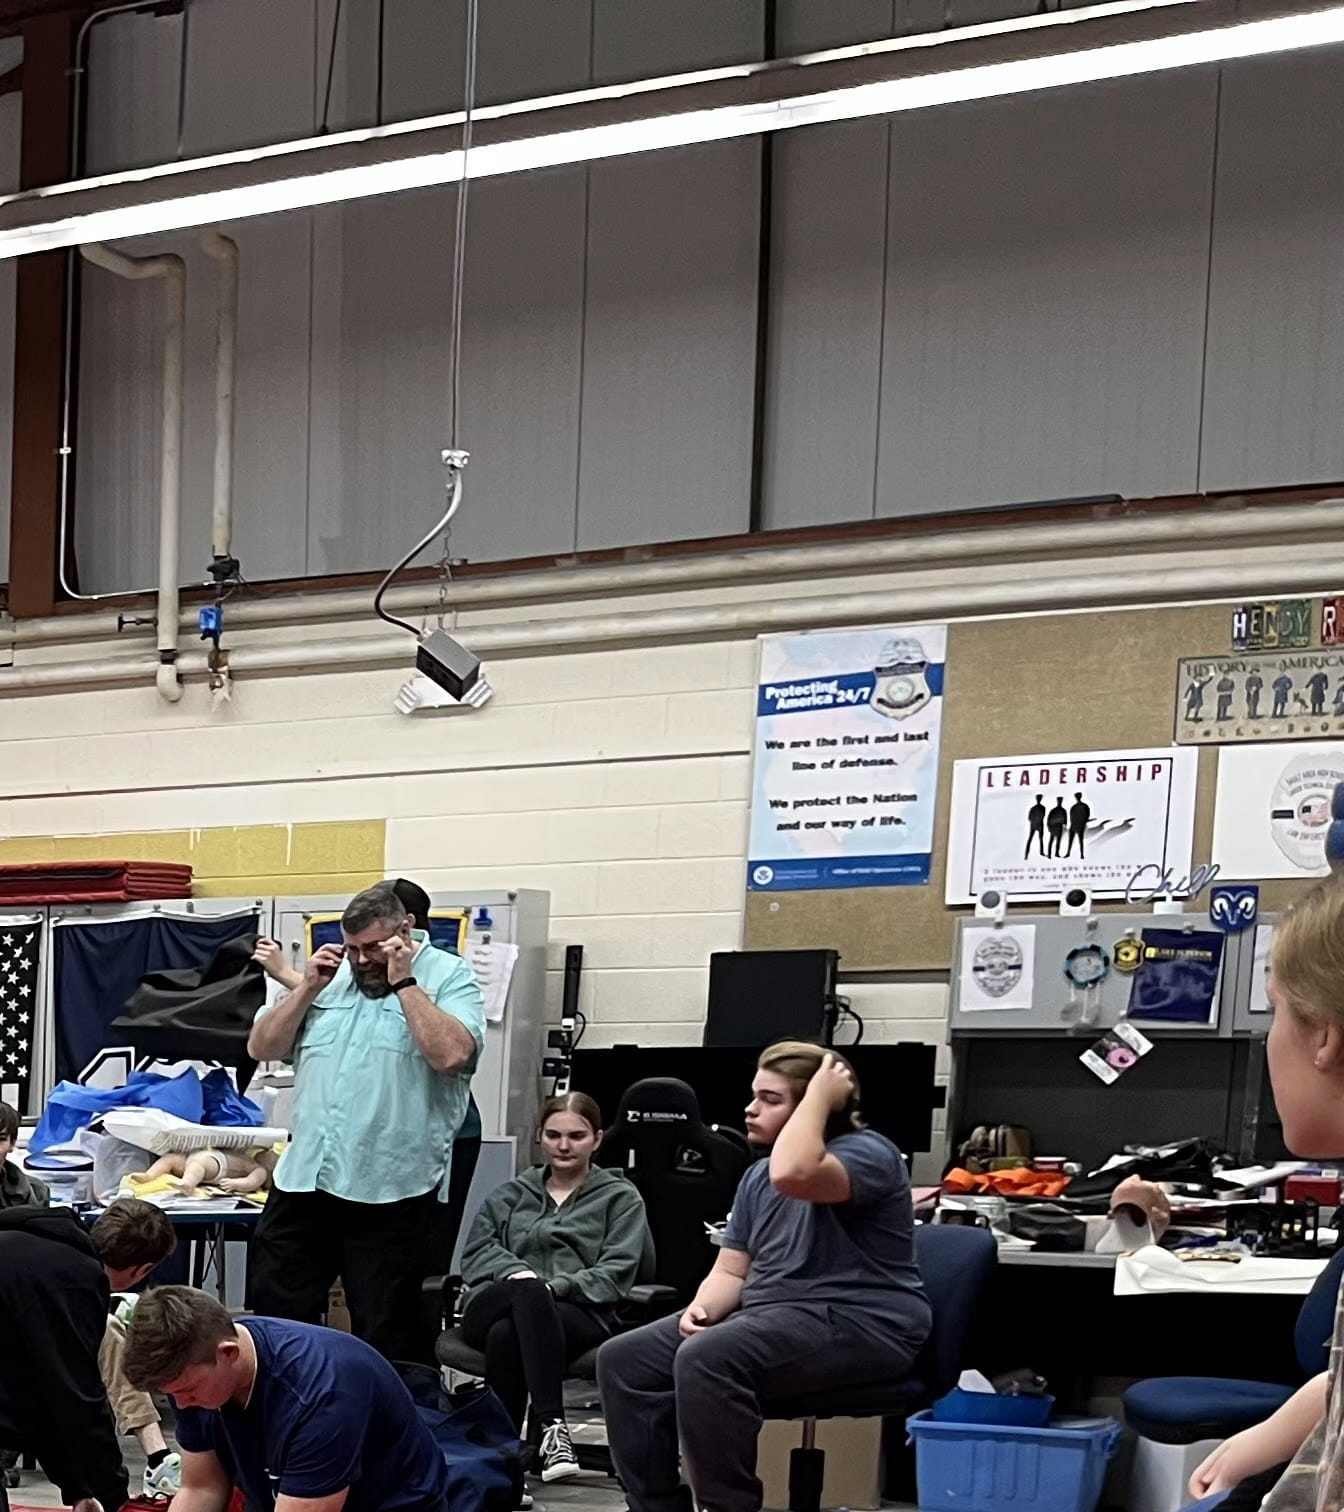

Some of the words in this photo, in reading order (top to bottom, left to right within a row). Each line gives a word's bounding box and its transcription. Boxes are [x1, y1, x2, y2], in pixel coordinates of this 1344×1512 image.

[765, 680, 839, 699] Protecting
[776, 694, 833, 710] America
[836, 687, 871, 703] 24/7
[765, 740, 785, 750] We
[790, 739, 811, 749] are
[816, 737, 838, 747] the
[842, 735, 869, 746] first
[874, 733, 899, 743] and
[904, 731, 929, 742] last
[792, 761, 816, 771] line
[821, 759, 835, 769] of
[839, 757, 898, 768] defense.
[987, 763, 1163, 788] LEADERSHIP
[768, 799, 789, 809] We
[792, 796, 841, 810] protect
[846, 794, 868, 804] the
[873, 792, 918, 804] Nation
[776, 821, 801, 831] and
[804, 820, 826, 829] our
[831, 819, 857, 830] way
[861, 816, 875, 827] of
[880, 815, 906, 826] life.
[1126, 863, 1221, 905] Chill
